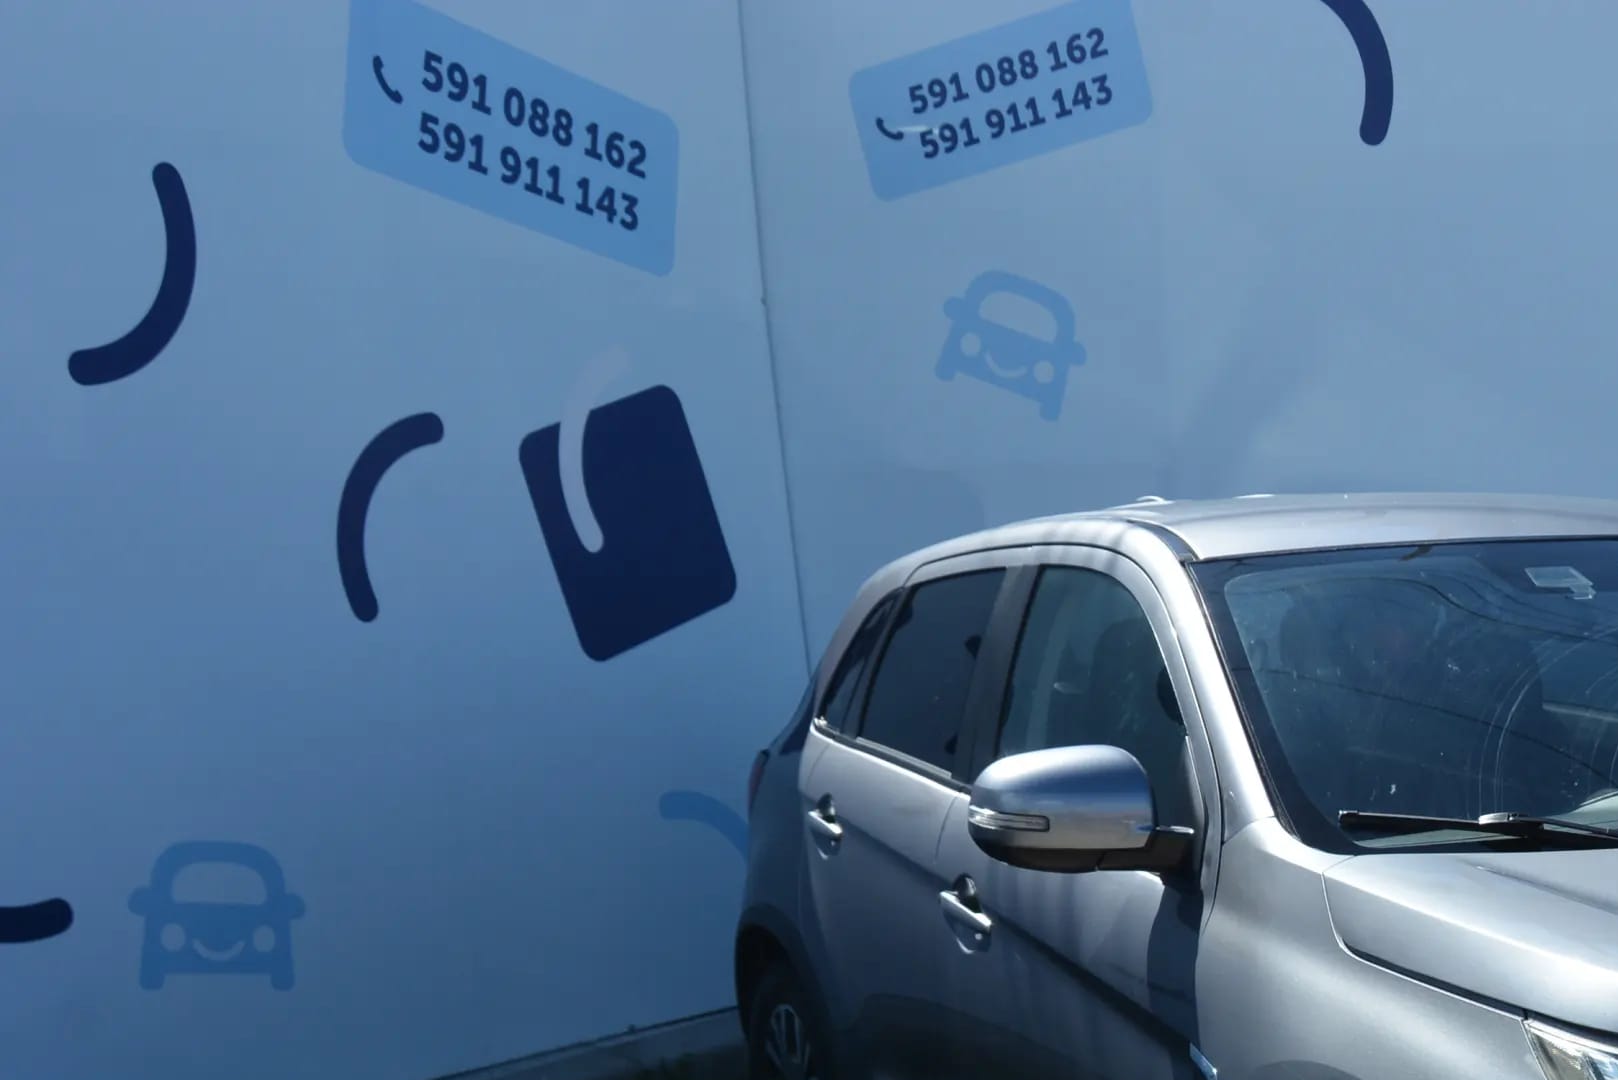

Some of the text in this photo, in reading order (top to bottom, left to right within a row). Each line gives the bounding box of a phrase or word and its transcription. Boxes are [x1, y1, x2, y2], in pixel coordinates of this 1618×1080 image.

[421, 50, 647, 180] 591 088 162
[907, 27, 1109, 115] 591 088 162
[919, 73, 1113, 159] 591 911 143
[417, 111, 640, 232] 591 911 143
